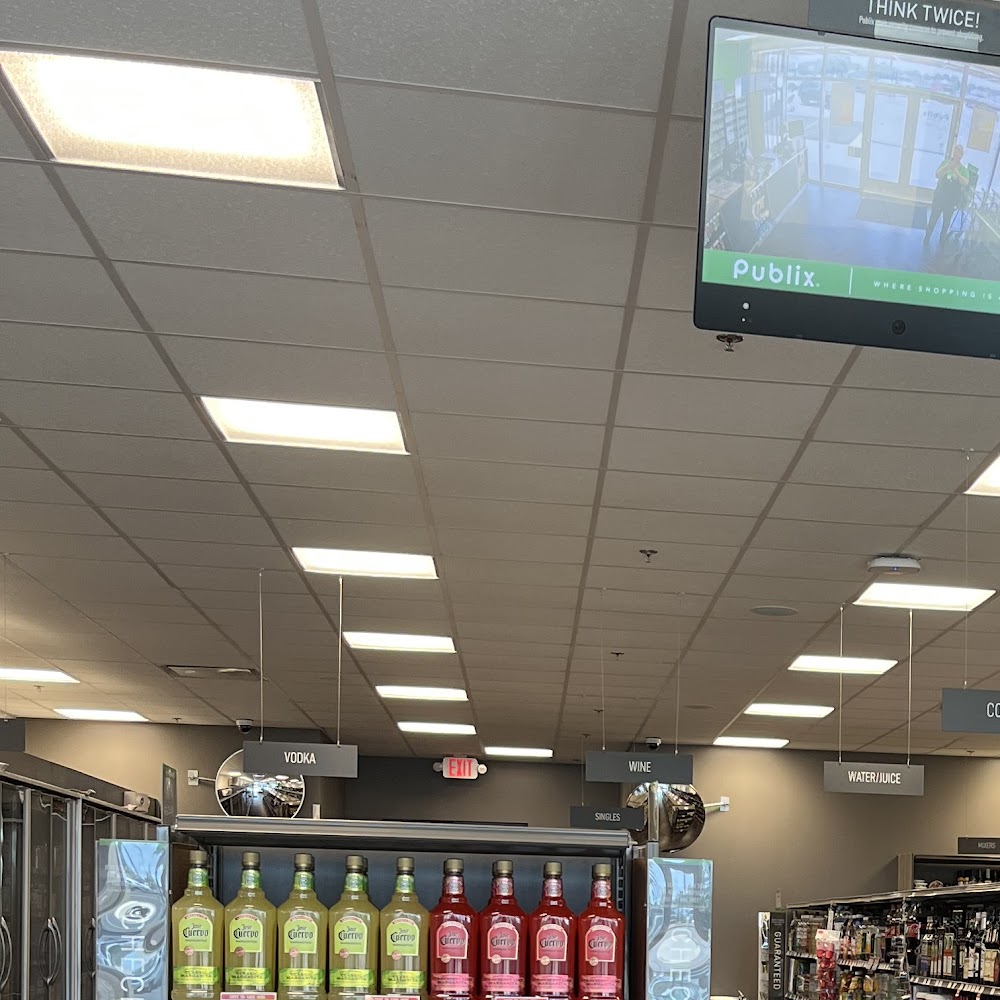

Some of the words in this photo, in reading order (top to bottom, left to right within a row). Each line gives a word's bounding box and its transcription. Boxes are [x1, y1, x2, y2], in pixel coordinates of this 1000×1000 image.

[868, 0, 919, 20] THINK
[922, 4, 980, 29] TWICE!
[733, 258, 815, 288] Publix
[873, 280, 912, 292] WHERE
[918, 285, 976, 299] SHOPPING
[284, 751, 317, 766] VODKA
[448, 757, 475, 778] EXIT
[628, 760, 653, 774] WINE
[847, 770, 902, 785] WATER/JUICE
[594, 812, 621, 823] SINGLES
[977, 841, 997, 850] MIXERS
[182, 927, 209, 938] Cuervo
[233, 928, 259, 939] Cuervo
[287, 929, 313, 940] Cuervo
[338, 930, 364, 941] Cuervo
[390, 932, 416, 943] Cuervo
[772, 931, 782, 991] GUARANTEED
